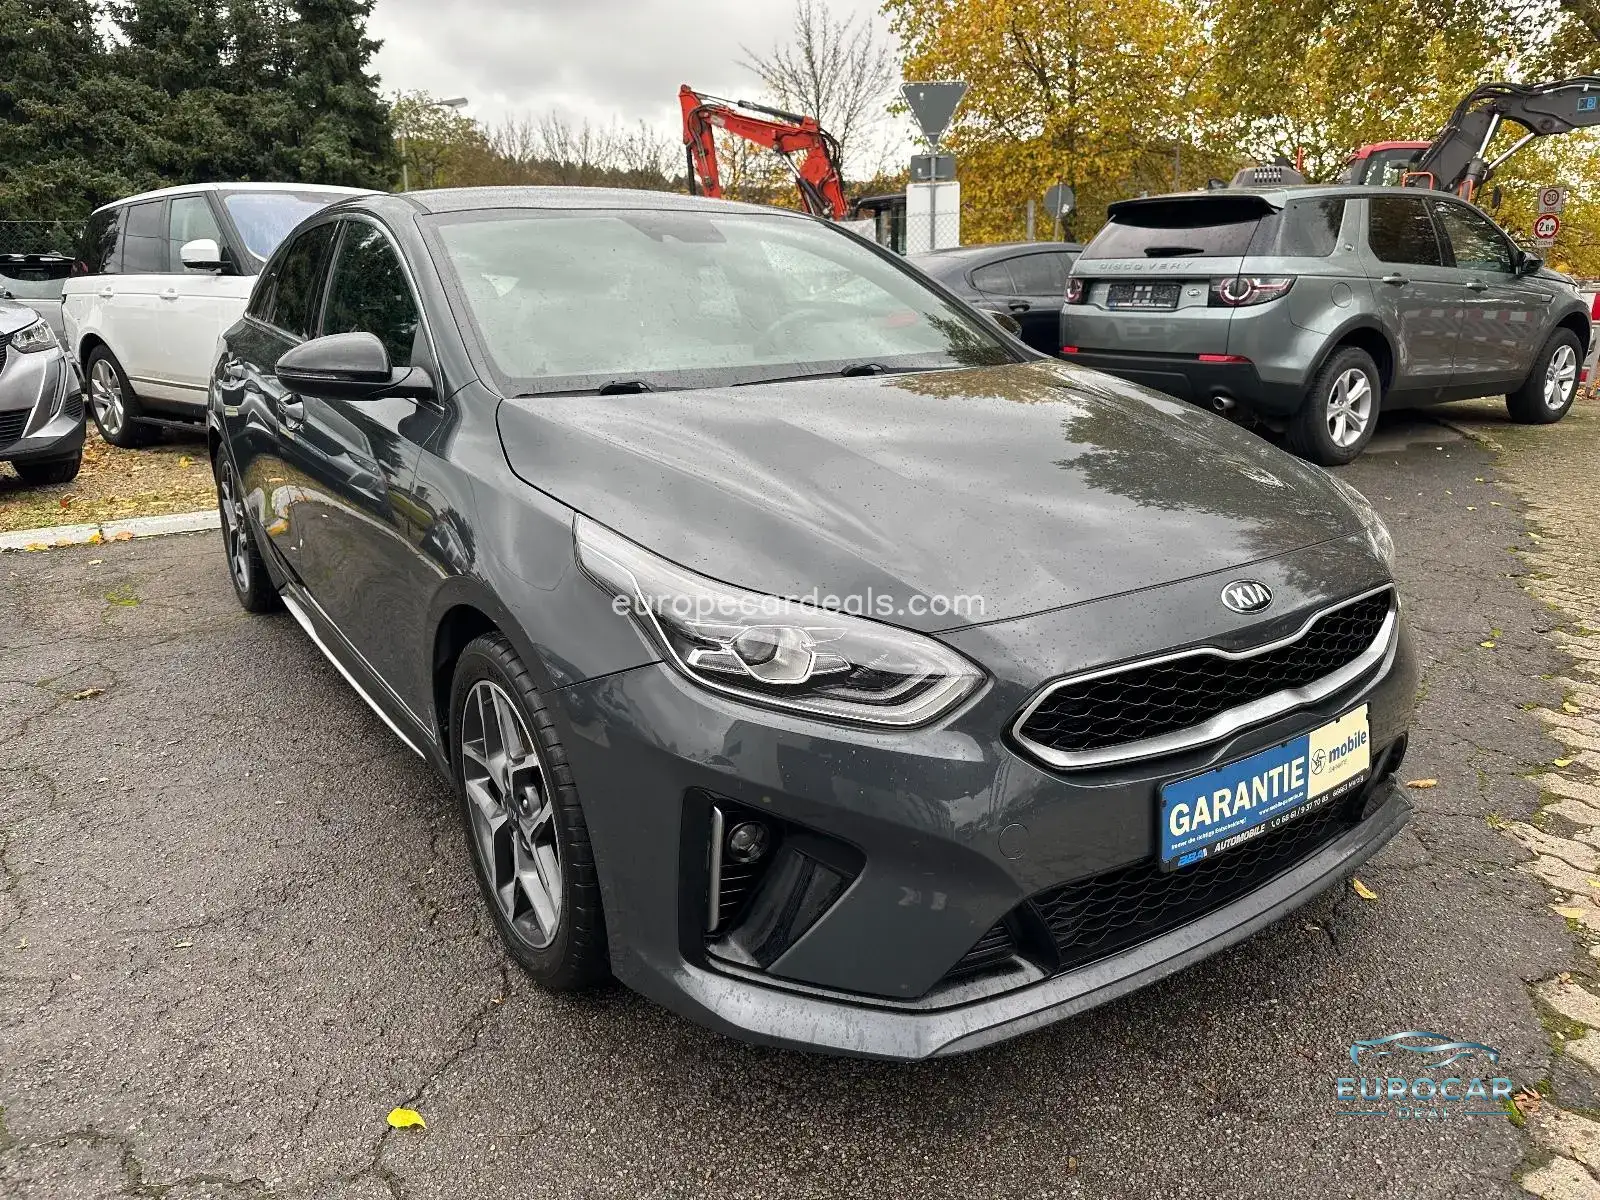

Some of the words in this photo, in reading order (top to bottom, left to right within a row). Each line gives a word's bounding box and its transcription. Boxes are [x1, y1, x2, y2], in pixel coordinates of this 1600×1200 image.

[1546, 193, 1556, 202] 30
[1098, 262, 1193, 271] DISCOVERY
[1227, 583, 1271, 608] KIA
[1328, 729, 1367, 763] mobile
[1169, 756, 1305, 837] GARANTIE
[1213, 823, 1266, 853] AUTOMOBILE
